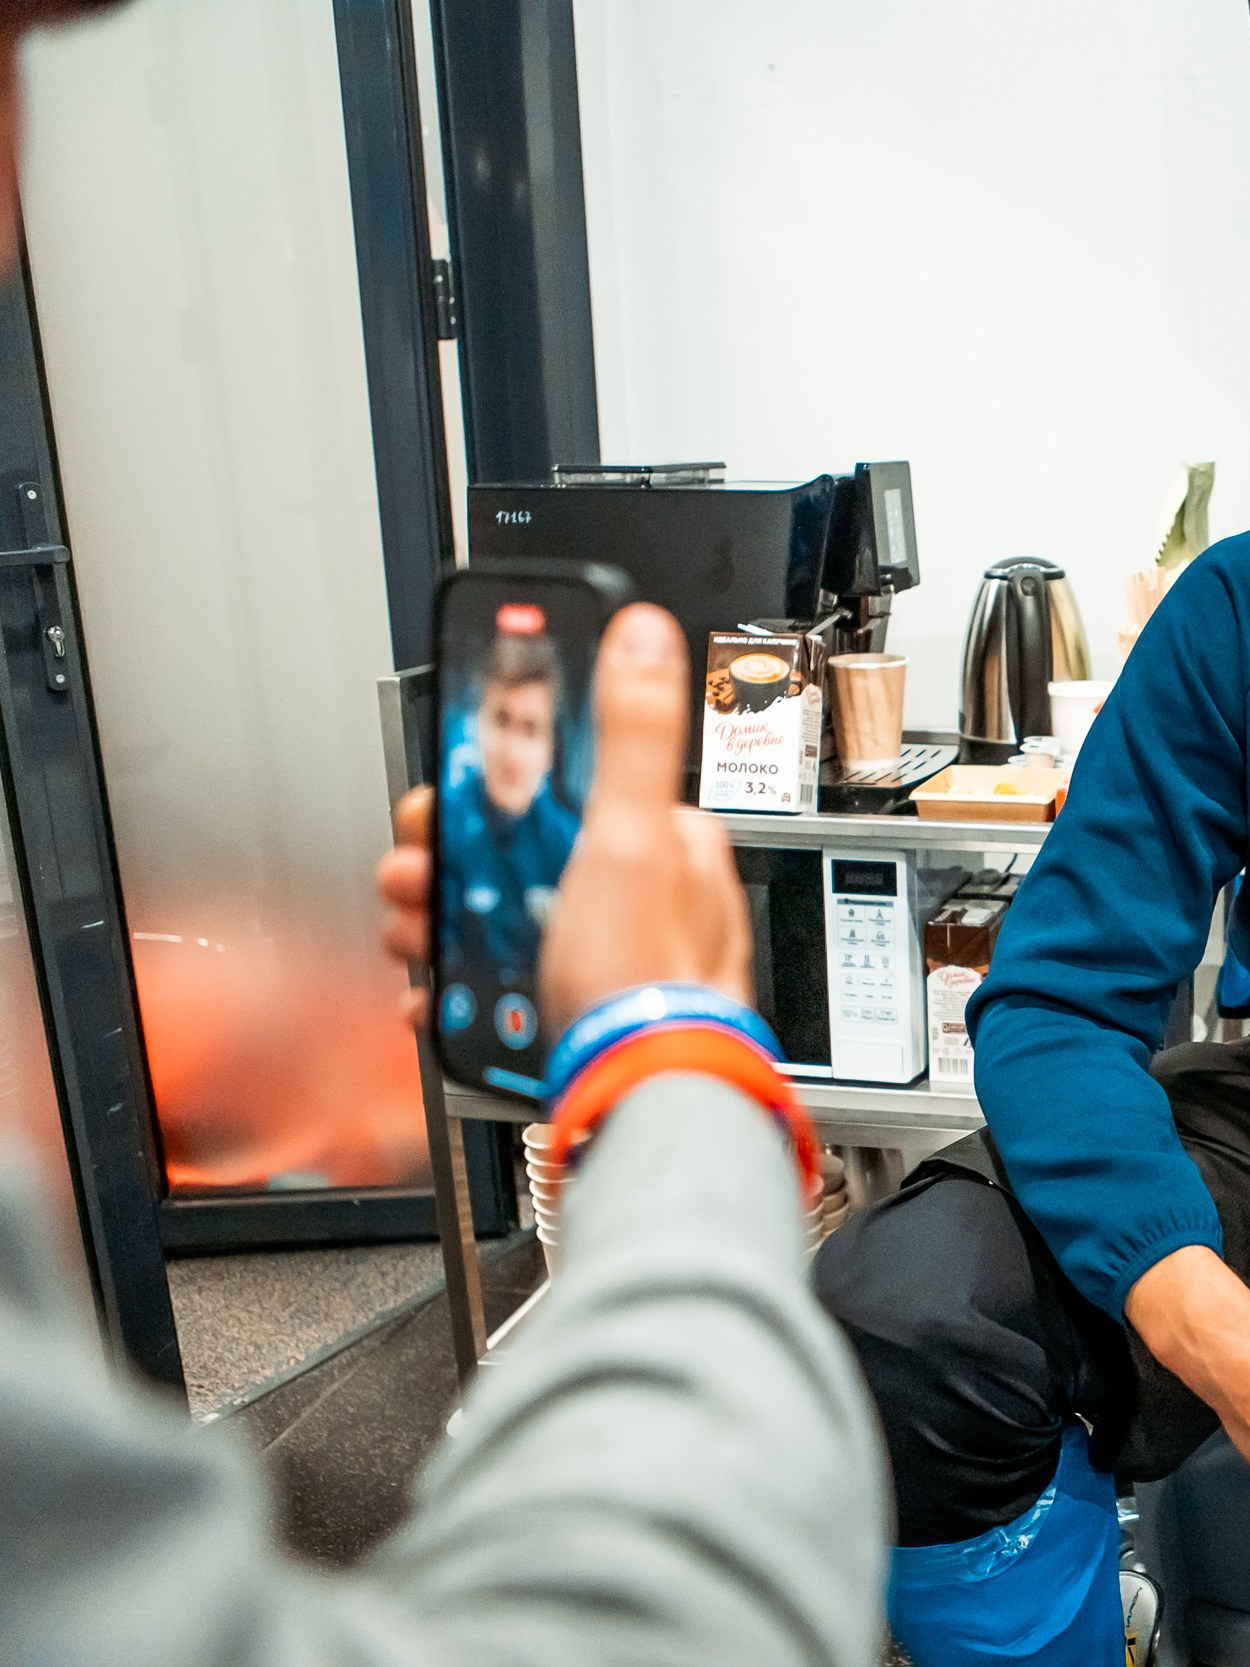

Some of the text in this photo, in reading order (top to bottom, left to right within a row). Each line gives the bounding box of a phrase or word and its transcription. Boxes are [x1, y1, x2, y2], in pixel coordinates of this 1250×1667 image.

[715, 721, 769, 741] Домик
[735, 731, 785, 755] деревне
[716, 762, 779, 775] МОЛОКО
